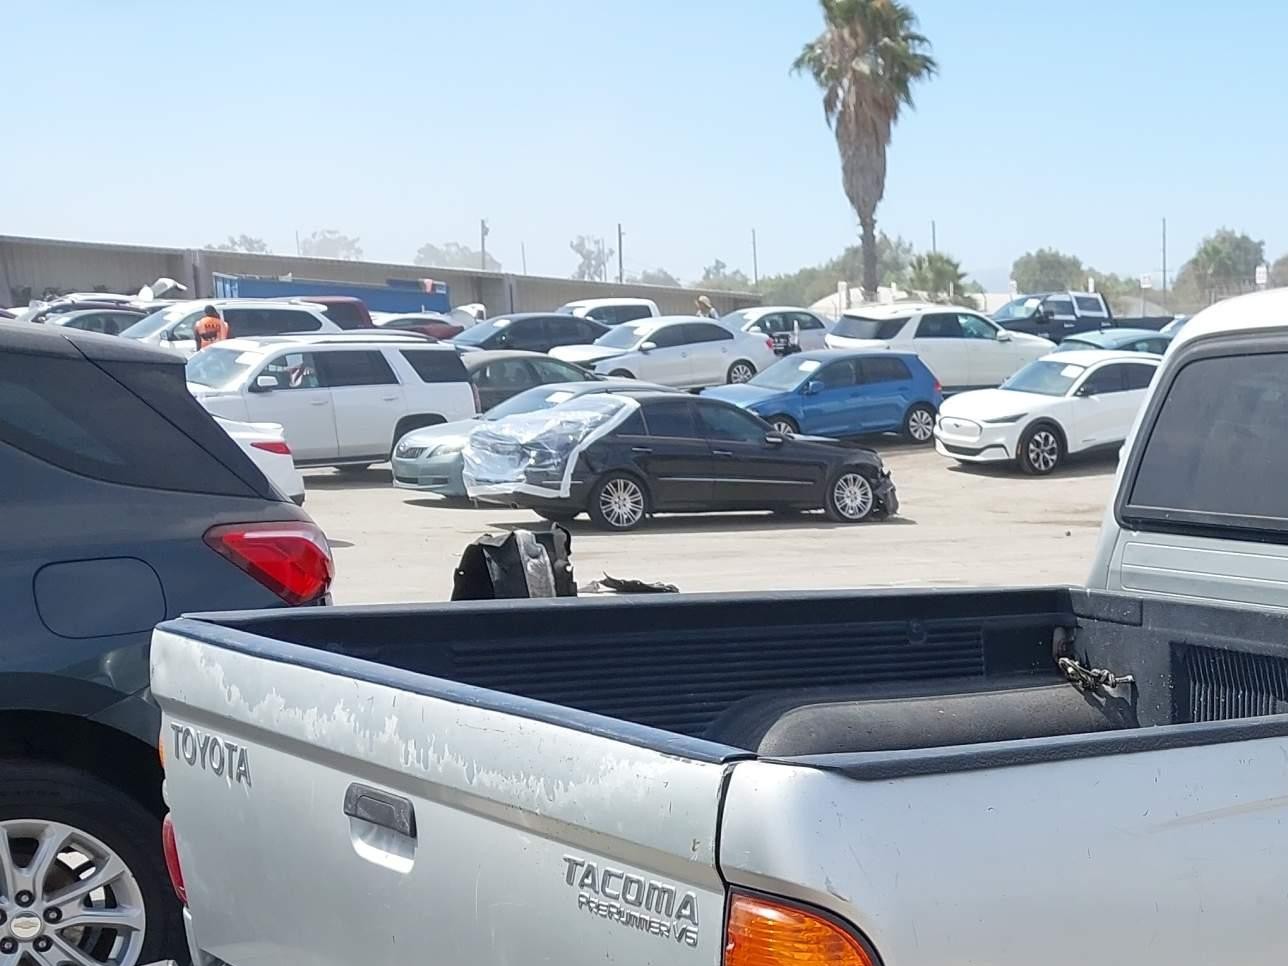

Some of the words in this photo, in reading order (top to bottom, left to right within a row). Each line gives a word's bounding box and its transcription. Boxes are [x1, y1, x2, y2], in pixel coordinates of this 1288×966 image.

[170, 721, 252, 788] TOYOTA
[562, 854, 699, 926] TACOMA
[672, 920, 699, 947] V6
